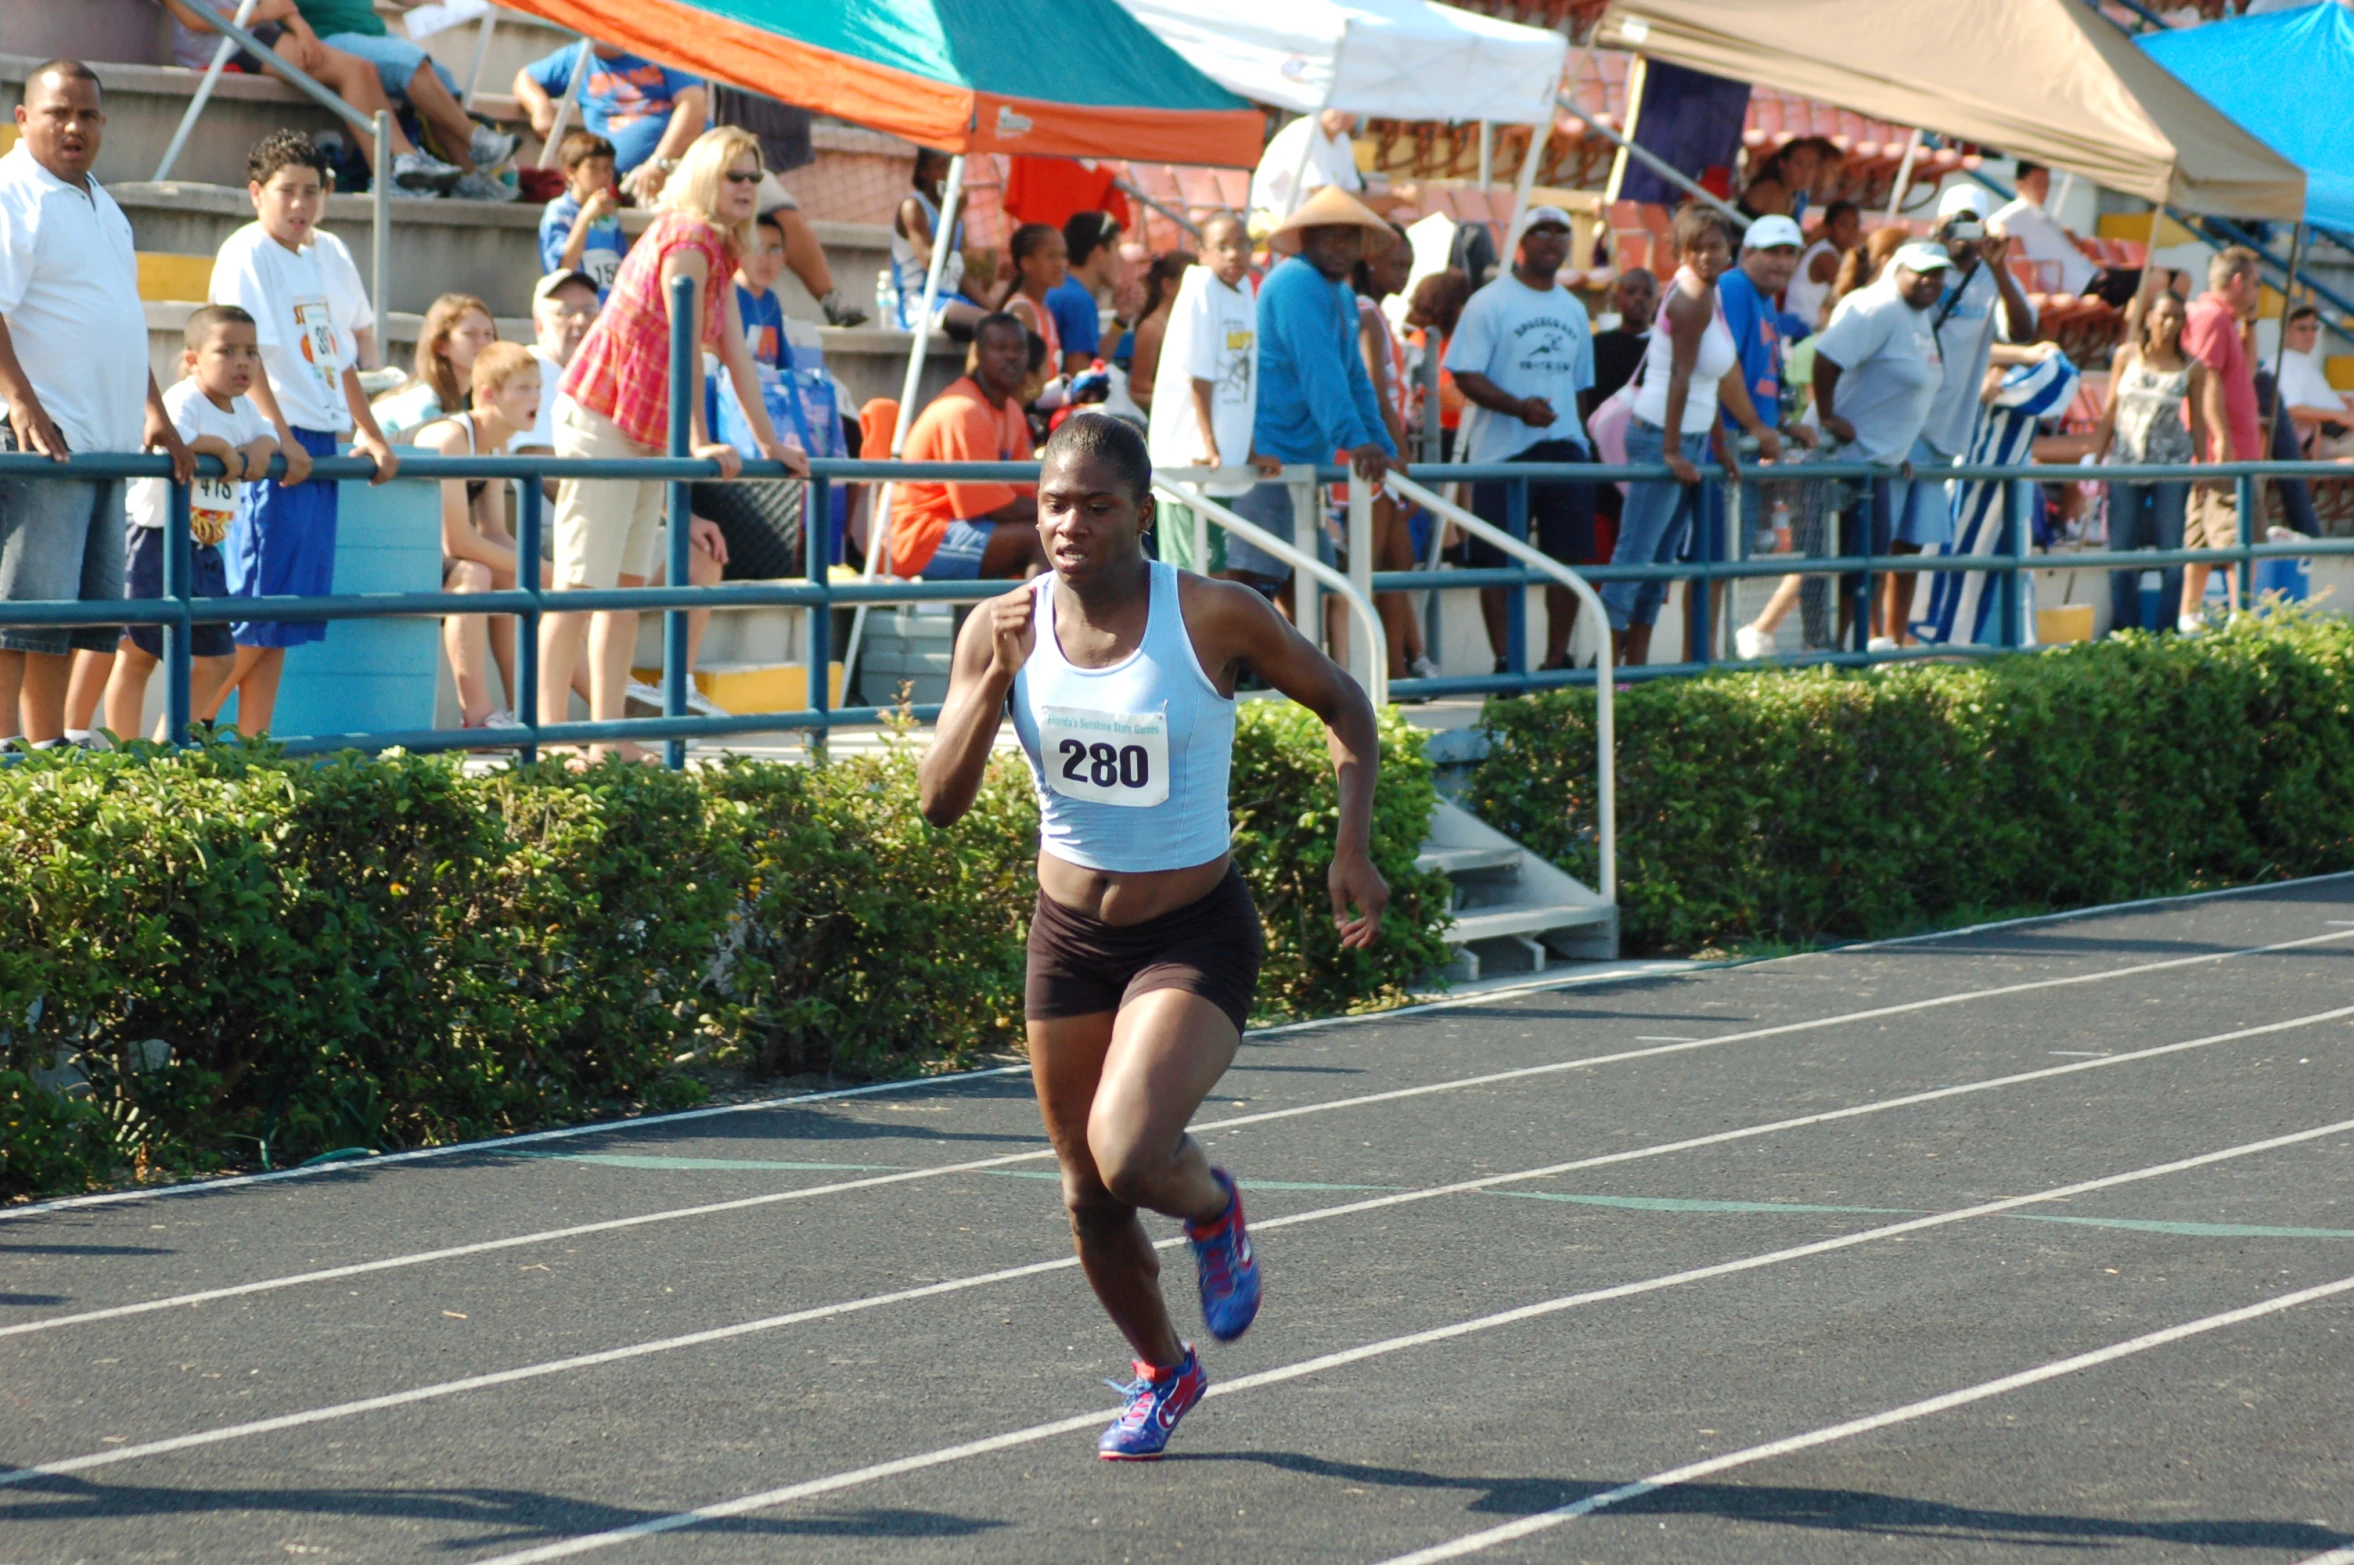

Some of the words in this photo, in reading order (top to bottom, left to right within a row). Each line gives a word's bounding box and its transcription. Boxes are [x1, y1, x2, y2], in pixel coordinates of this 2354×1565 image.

[1047, 713, 1078, 728] Florida's
[1080, 718, 1111, 732] Sunshine
[1113, 722, 1132, 734] State
[1134, 724, 1159, 735] Games
[1059, 739, 1149, 788] 280
